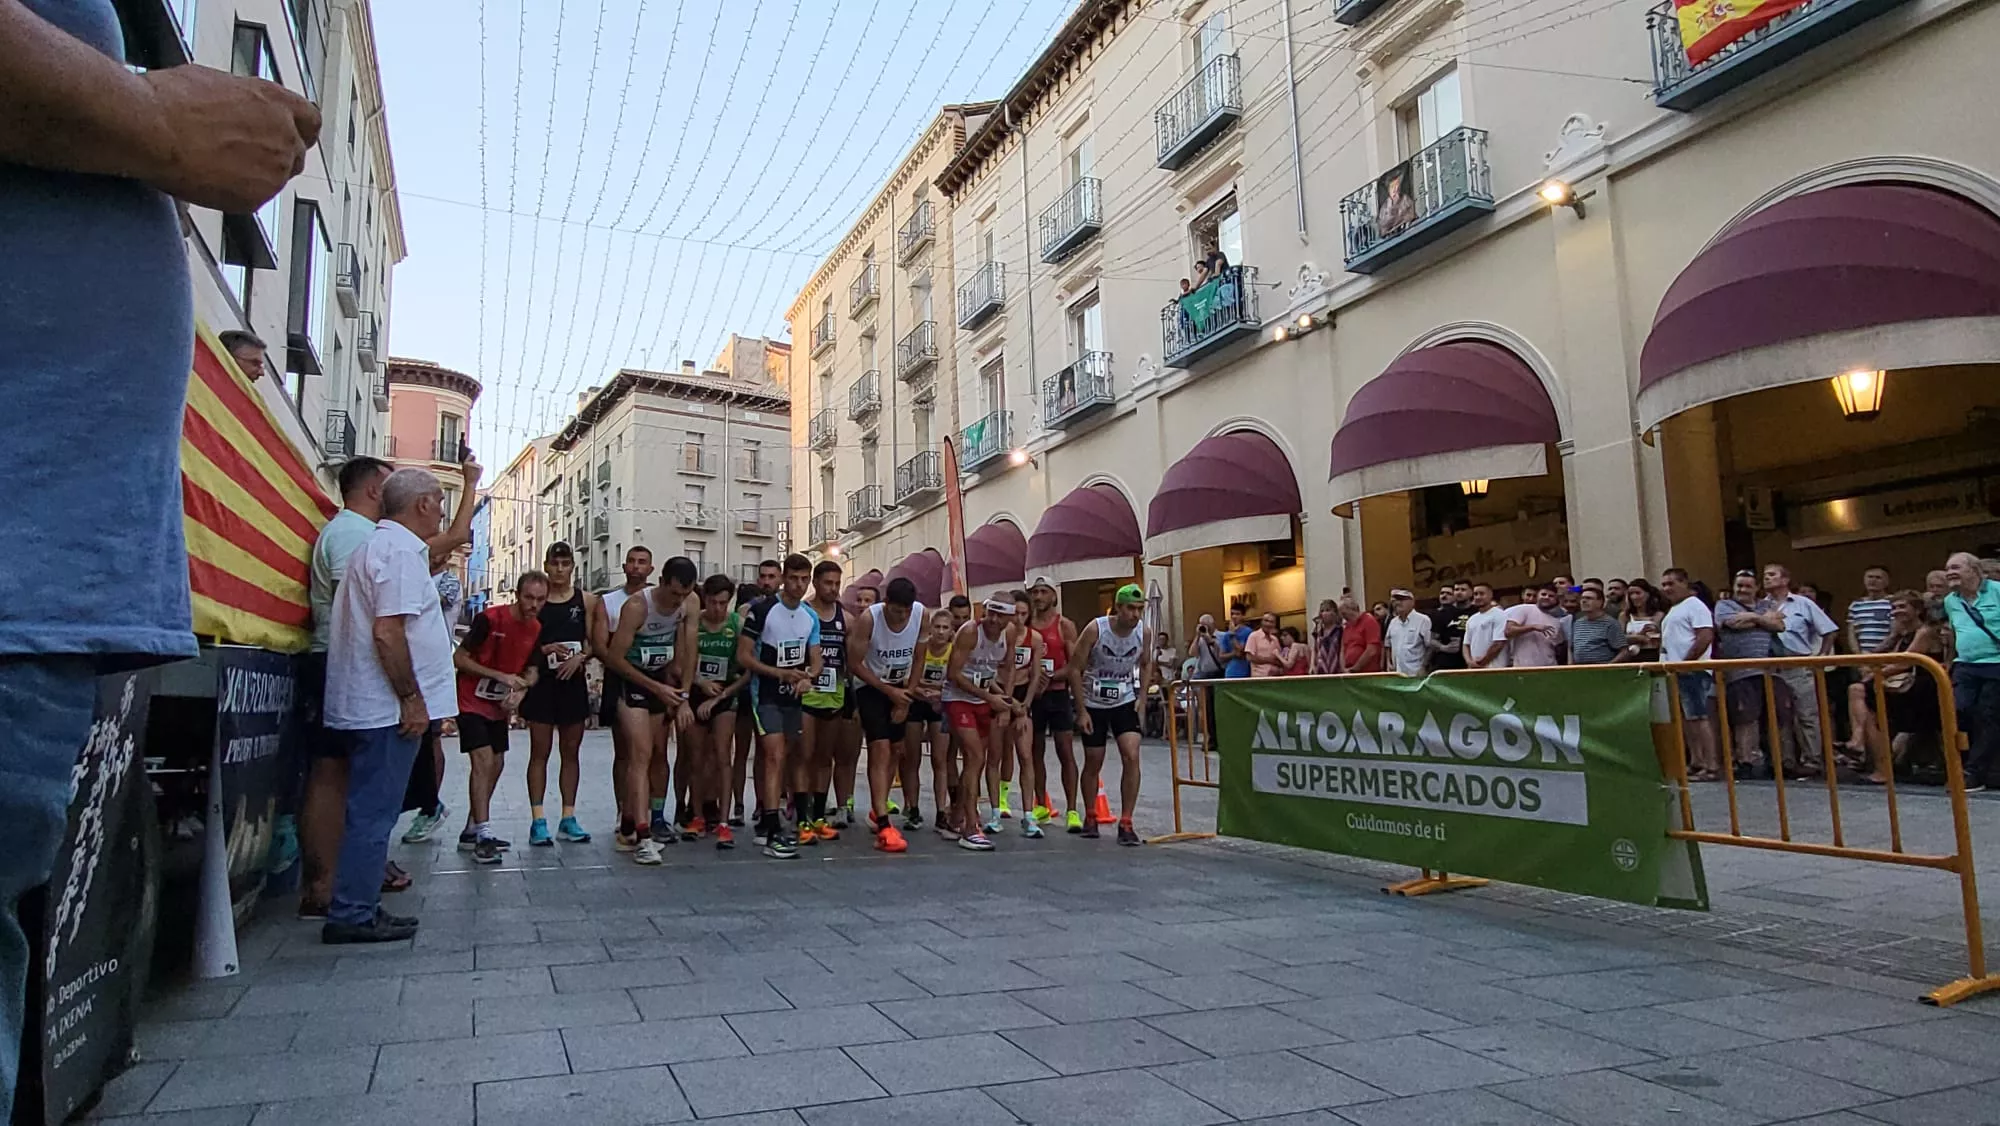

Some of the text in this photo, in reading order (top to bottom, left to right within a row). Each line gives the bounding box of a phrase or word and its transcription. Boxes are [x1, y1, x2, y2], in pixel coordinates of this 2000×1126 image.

[777, 521, 789, 566] HOST
[876, 647, 913, 659] TARBES
[1252, 697, 1584, 764] ALTOARAGÓN
[1276, 762, 1541, 813] SUPERMERCADOS
[1346, 812, 1447, 841] Cuidamos de ti
[59, 958, 118, 1004] Deportivo
